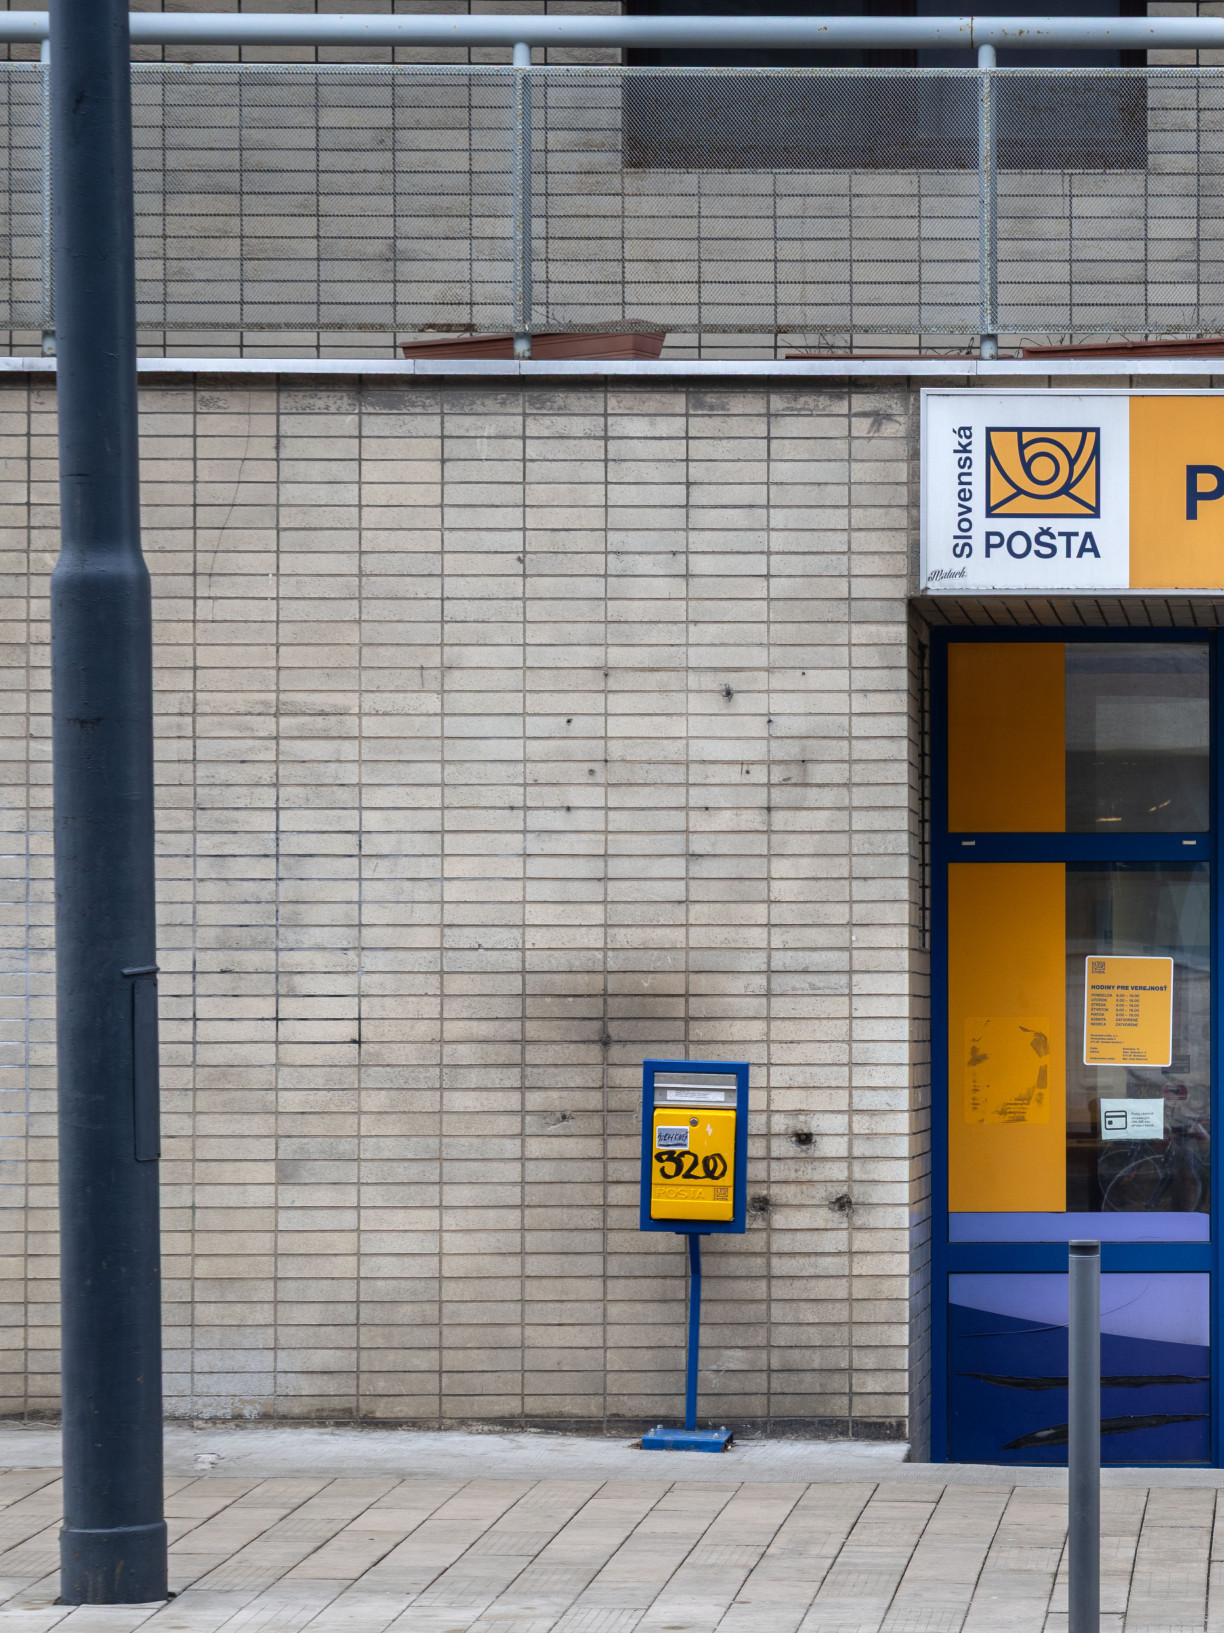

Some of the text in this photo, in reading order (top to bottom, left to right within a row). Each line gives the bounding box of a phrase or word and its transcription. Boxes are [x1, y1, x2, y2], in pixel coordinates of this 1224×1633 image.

[953, 426, 972, 559] Slovenská
[985, 527, 1101, 559] POŠTA
[654, 1150, 727, 1181] 320
